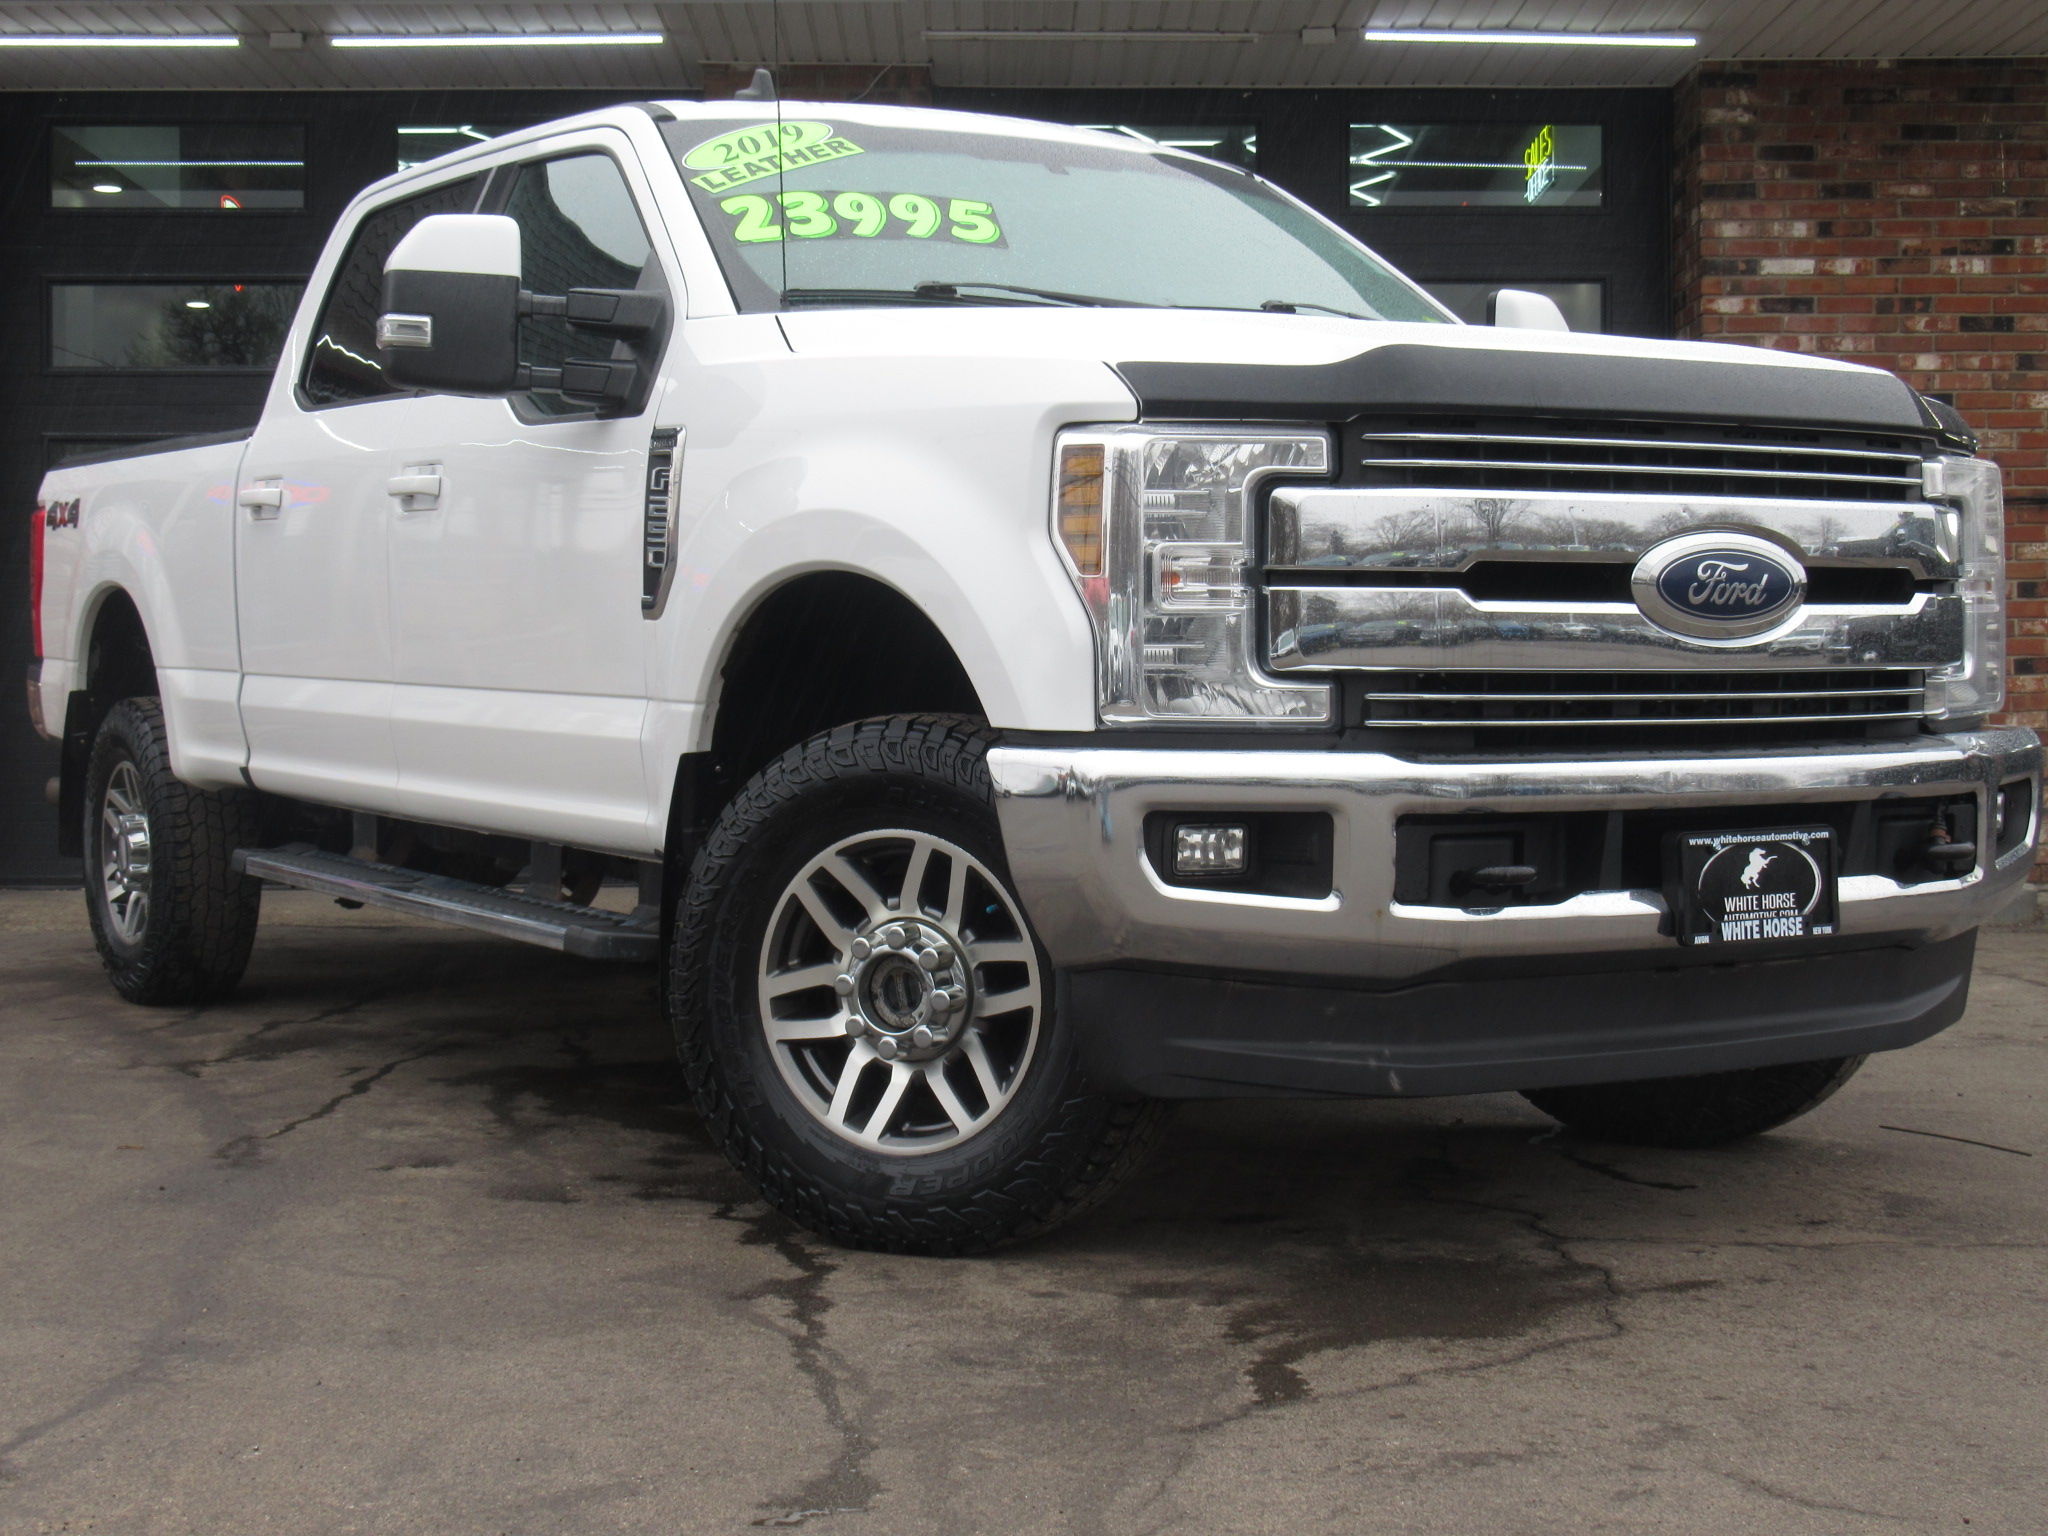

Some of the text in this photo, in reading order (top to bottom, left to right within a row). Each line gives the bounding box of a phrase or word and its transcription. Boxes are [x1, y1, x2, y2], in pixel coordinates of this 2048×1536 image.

[700, 138, 855, 192] LEATHER
[713, 123, 804, 165] 2019
[720, 191, 1001, 244] 23995
[1688, 560, 1769, 605] Ford
[1688, 830, 1829, 846] www.whitehorseautomotive.com
[1724, 892, 1797, 912] WHITE HORSE
[1721, 916, 1804, 941] WHITE HORSE
